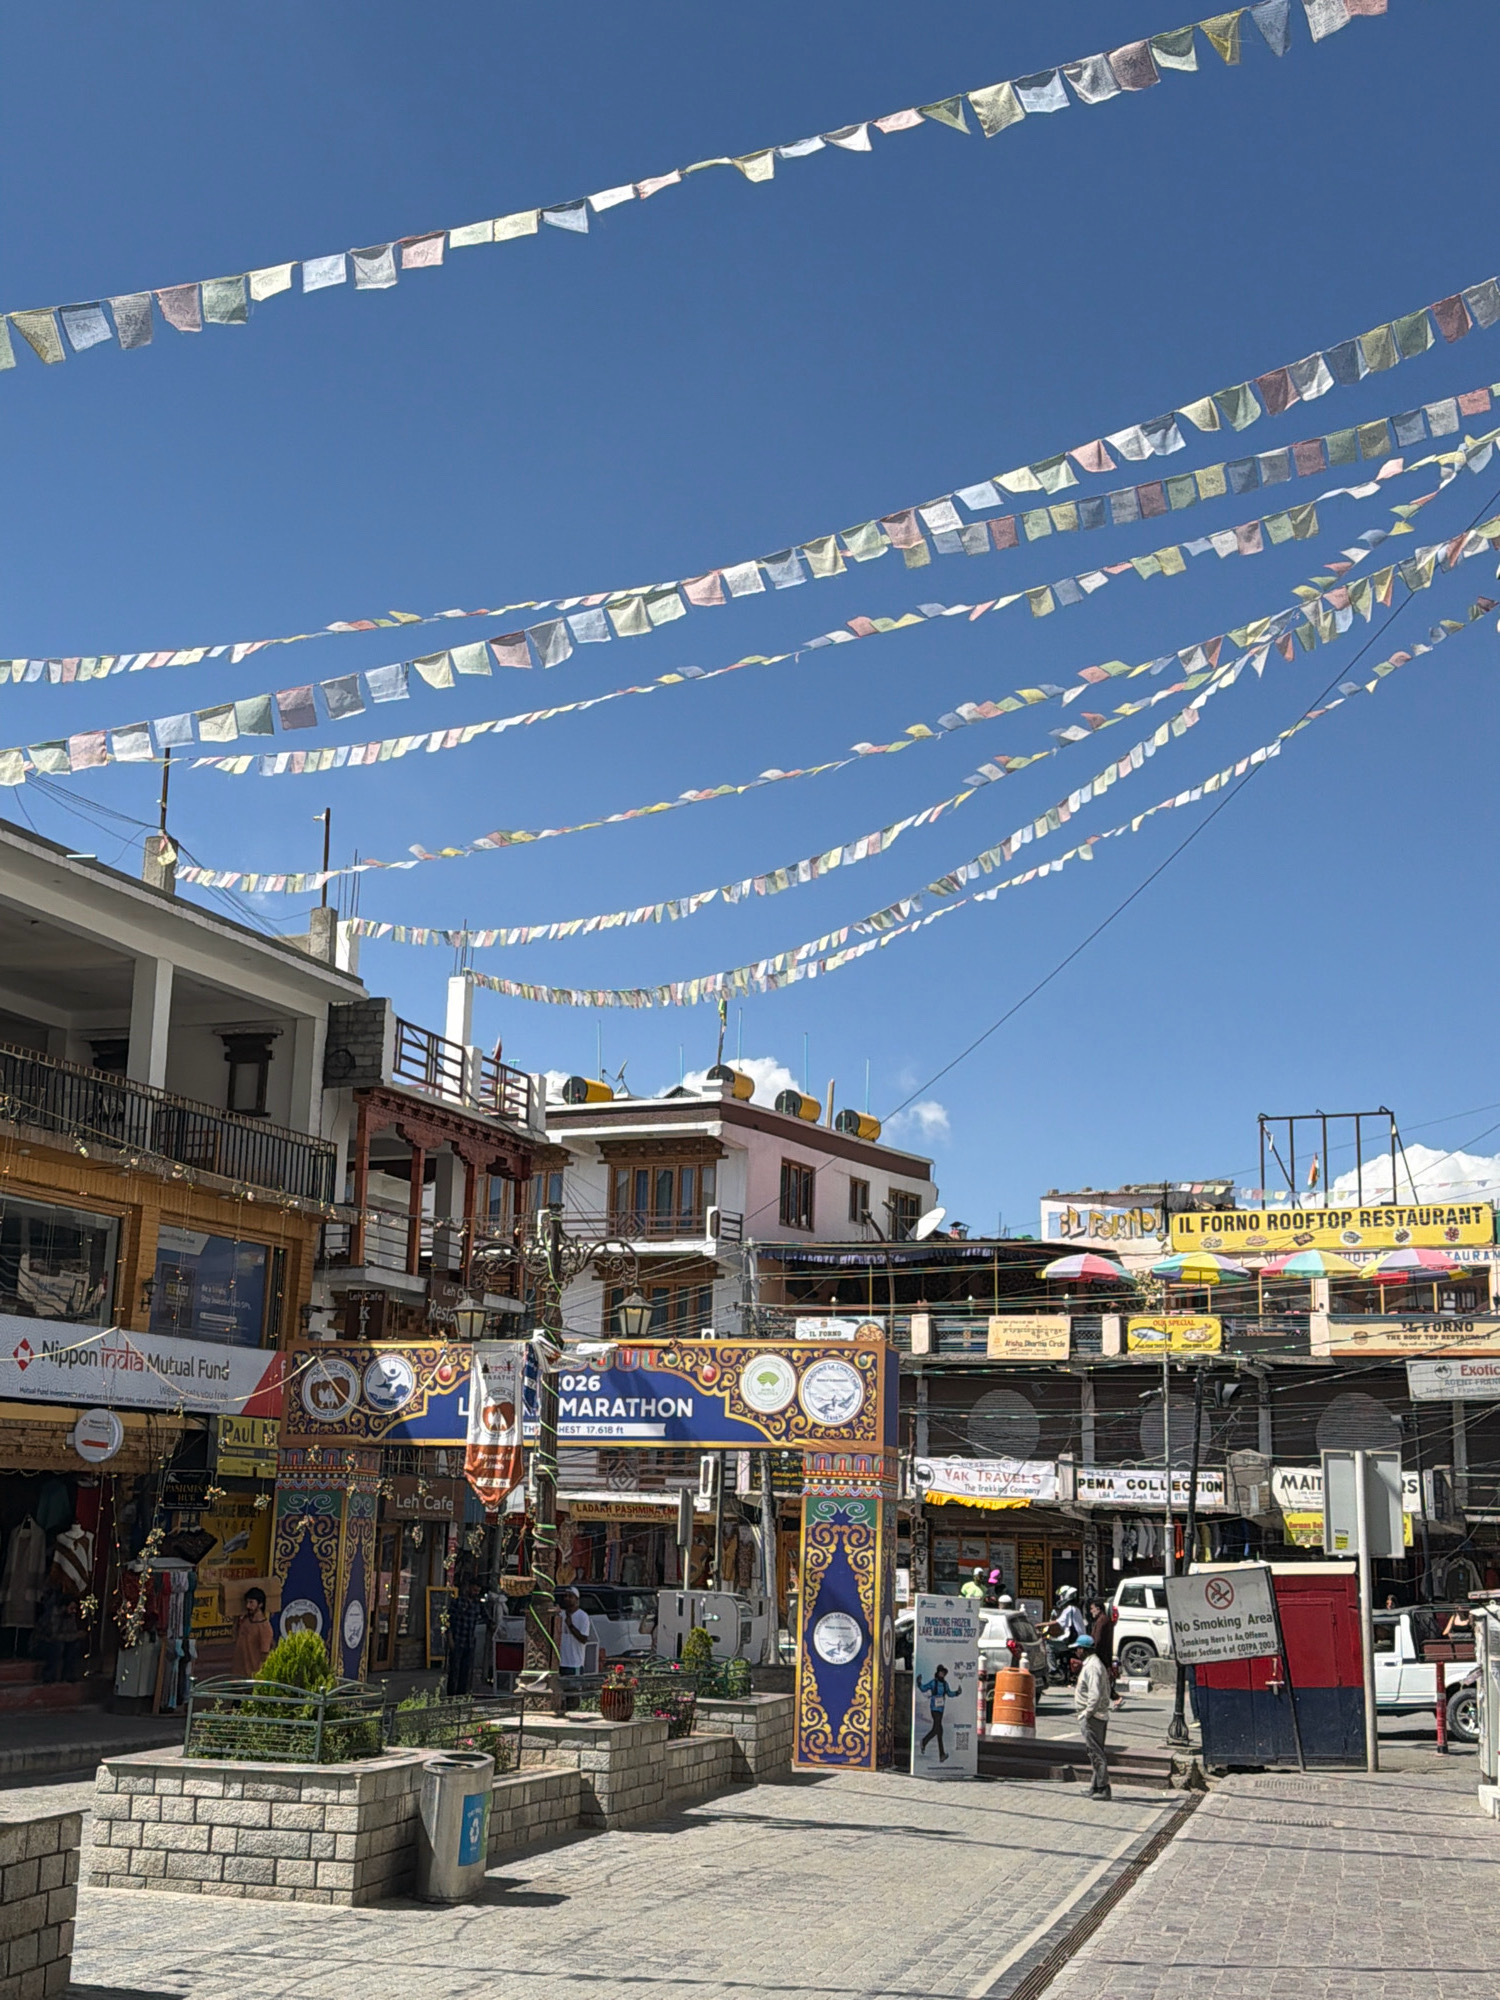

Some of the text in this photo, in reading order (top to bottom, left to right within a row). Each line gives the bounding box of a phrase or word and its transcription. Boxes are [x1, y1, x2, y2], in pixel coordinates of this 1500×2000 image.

[1180, 1206, 1484, 1233] IL FORNO ROOFTOP RESTAURANT
[1168, 1319, 1196, 1327] SPECIAL
[1401, 1320, 1475, 1333] IL FORNO
[42, 1340, 98, 1369] Nippon
[147, 1353, 194, 1378] Mutual
[198, 1358, 230, 1381] Fund
[1461, 1364, 1500, 1376] Exotic
[558, 1374, 601, 1392] 026
[558, 1397, 693, 1417] MARATHON
[616, 1426, 625, 1435] ft
[944, 1469, 1041, 1484] YAK TRAVELS
[964, 1484, 976, 1492] The
[1009, 1485, 1041, 1496] Company
[1078, 1478, 1223, 1493] PEMA COLLECION
[396, 1493, 454, 1511] Leh Cafe
[576, 1503, 612, 1514] LADAKH
[615, 1503, 661, 1515] PASHMINA
[1174, 1613, 1273, 1633] No Smoking Area
[1181, 1637, 1209, 1648] Smoking
[1210, 1635, 1226, 1643] Here
[1244, 1631, 1268, 1640] Offence
[1178, 1650, 1198, 1659] Under
[1199, 1646, 1222, 1657] Section
[1229, 1645, 1236, 1653] of
[1237, 1643, 1257, 1653] COTPA
[1258, 1641, 1275, 1651] 2003
